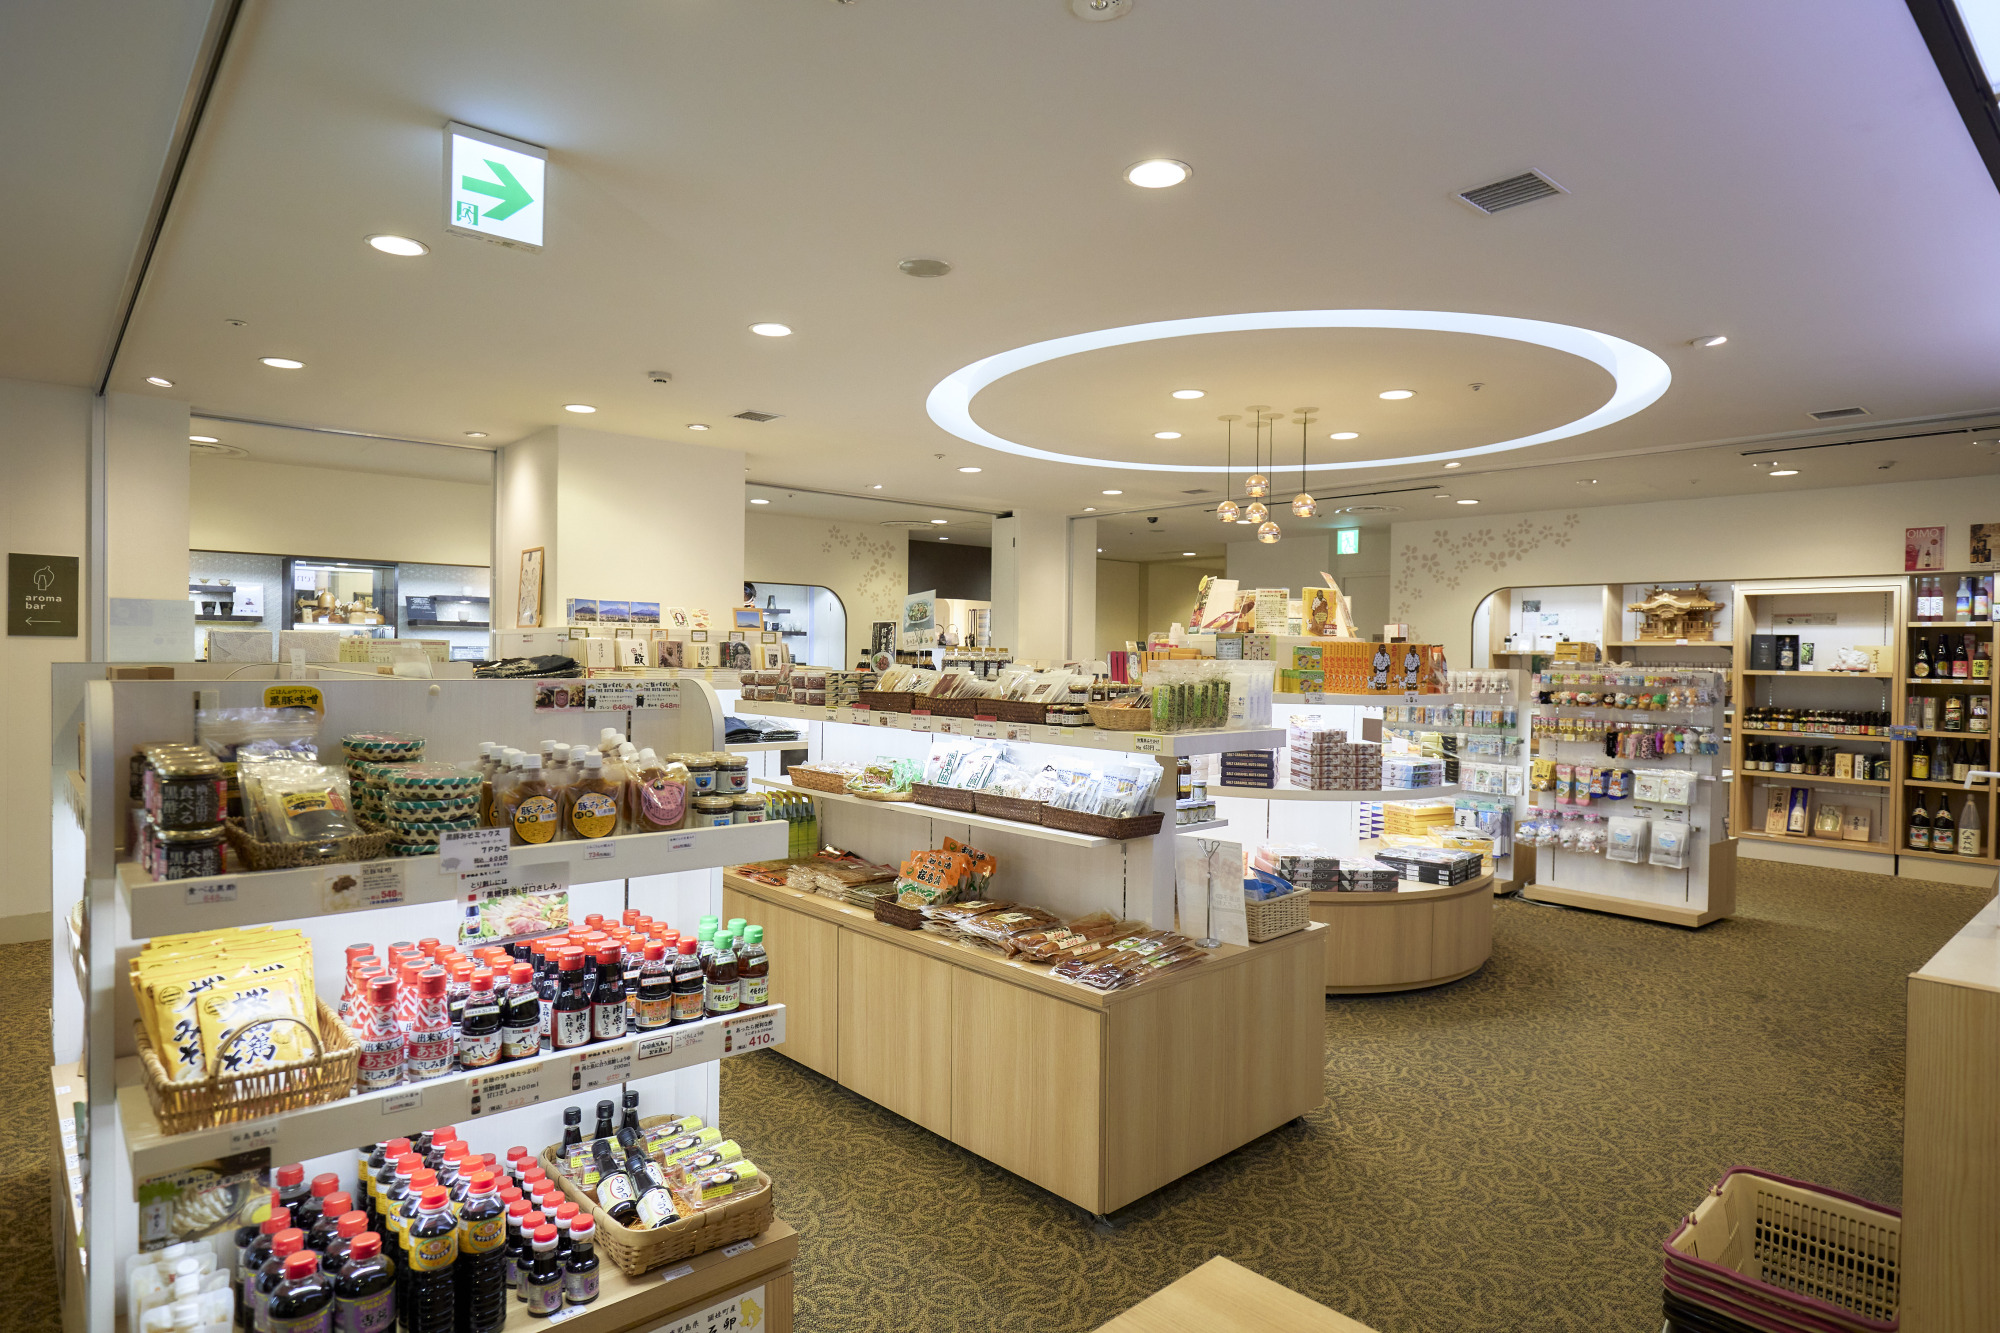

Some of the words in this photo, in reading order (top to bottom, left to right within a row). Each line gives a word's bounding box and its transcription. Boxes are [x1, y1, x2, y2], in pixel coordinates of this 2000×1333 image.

[1907, 528, 1938, 538] OIMO
[25, 594, 62, 602] aroma
[25, 602, 46, 610] bar
[270, 694, 318, 706] 黒豚味噌
[164, 786, 177, 814] 黒酢
[180, 786, 194, 824] 食べる
[578, 799, 611, 811] 豚みそ
[520, 803, 555, 816] 豚みそ
[188, 884, 235, 895] 食べる黒酢
[471, 879, 507, 888] とり刺しには
[417, 1028, 452, 1042] 出来立て
[749, 1033, 770, 1047] 410
[365, 1038, 402, 1052] 出来立て
[417, 1042, 453, 1057] あまくち
[365, 1051, 403, 1066] あまくち
